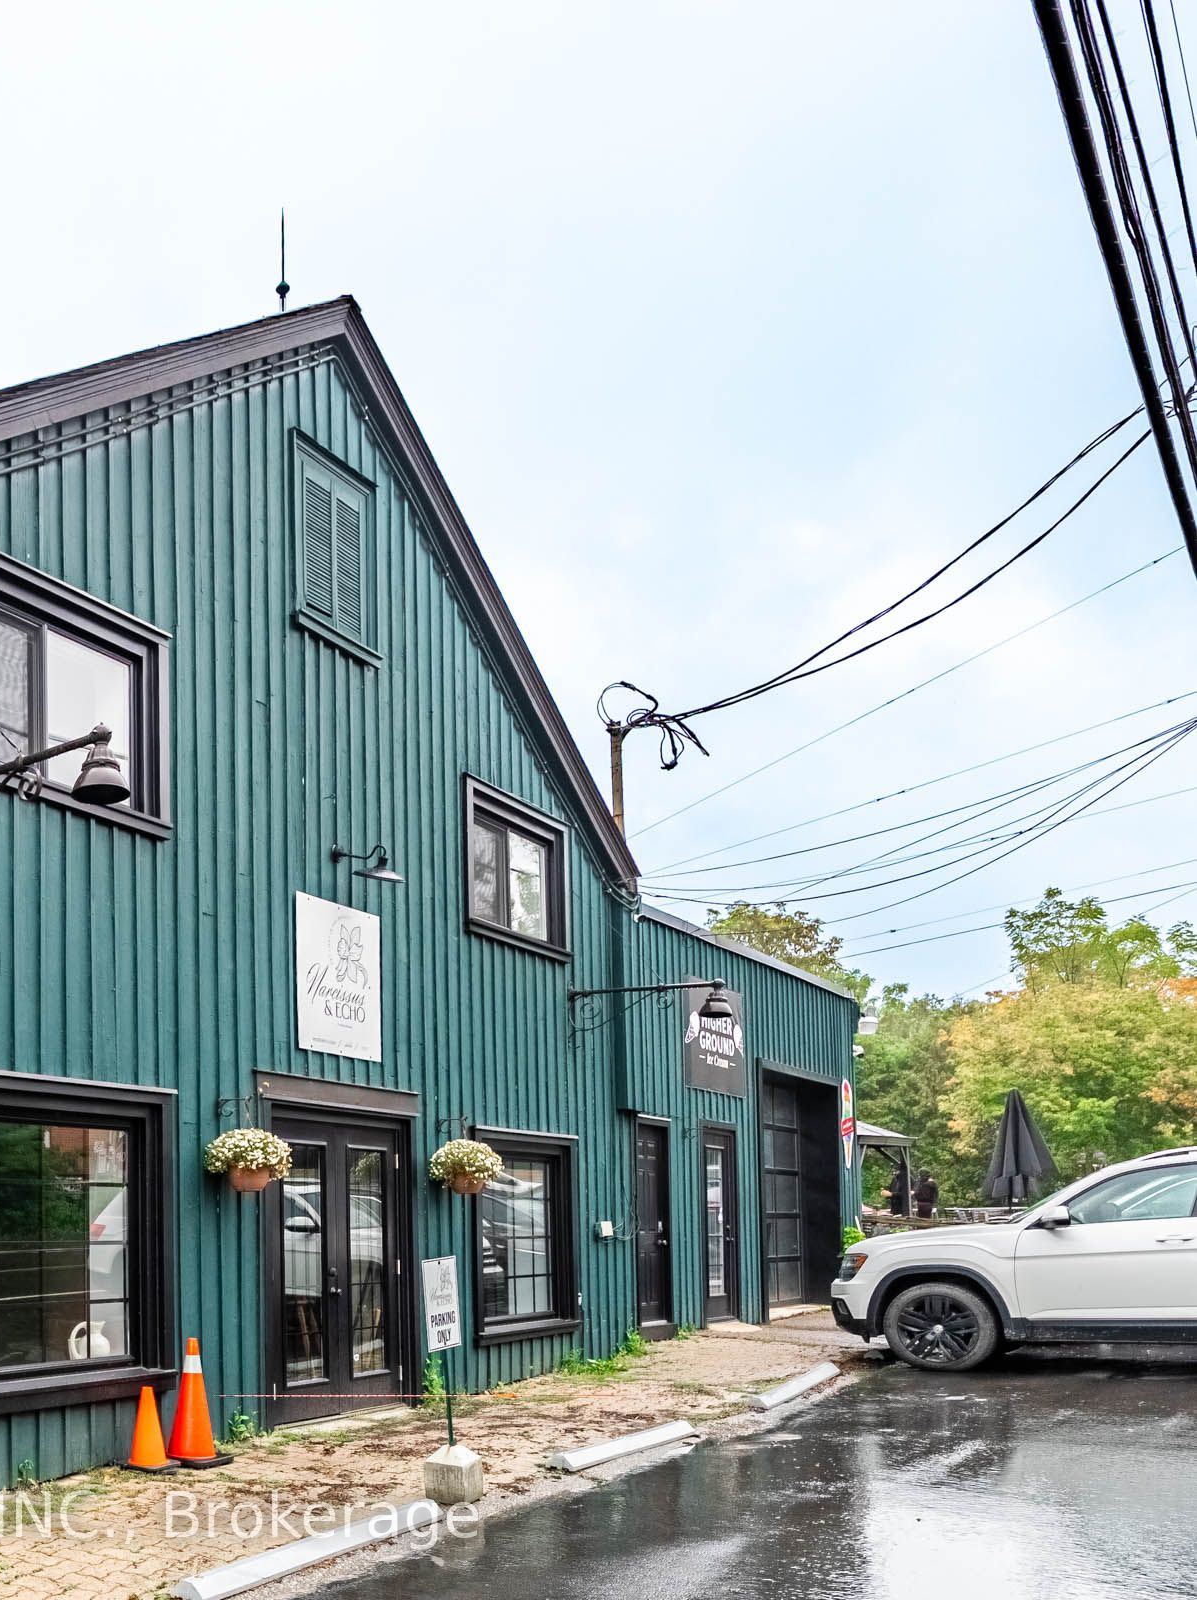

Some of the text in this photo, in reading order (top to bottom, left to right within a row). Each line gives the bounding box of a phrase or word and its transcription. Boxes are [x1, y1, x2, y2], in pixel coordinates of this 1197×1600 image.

[306, 962, 365, 1006] Narcissus
[324, 1000, 366, 1023] & ECHO
[701, 1016, 733, 1036] HIGHER
[700, 1030, 734, 1056] GROUND
[430, 1310, 455, 1327] PARKING
[437, 1328, 451, 1343] ONLY
